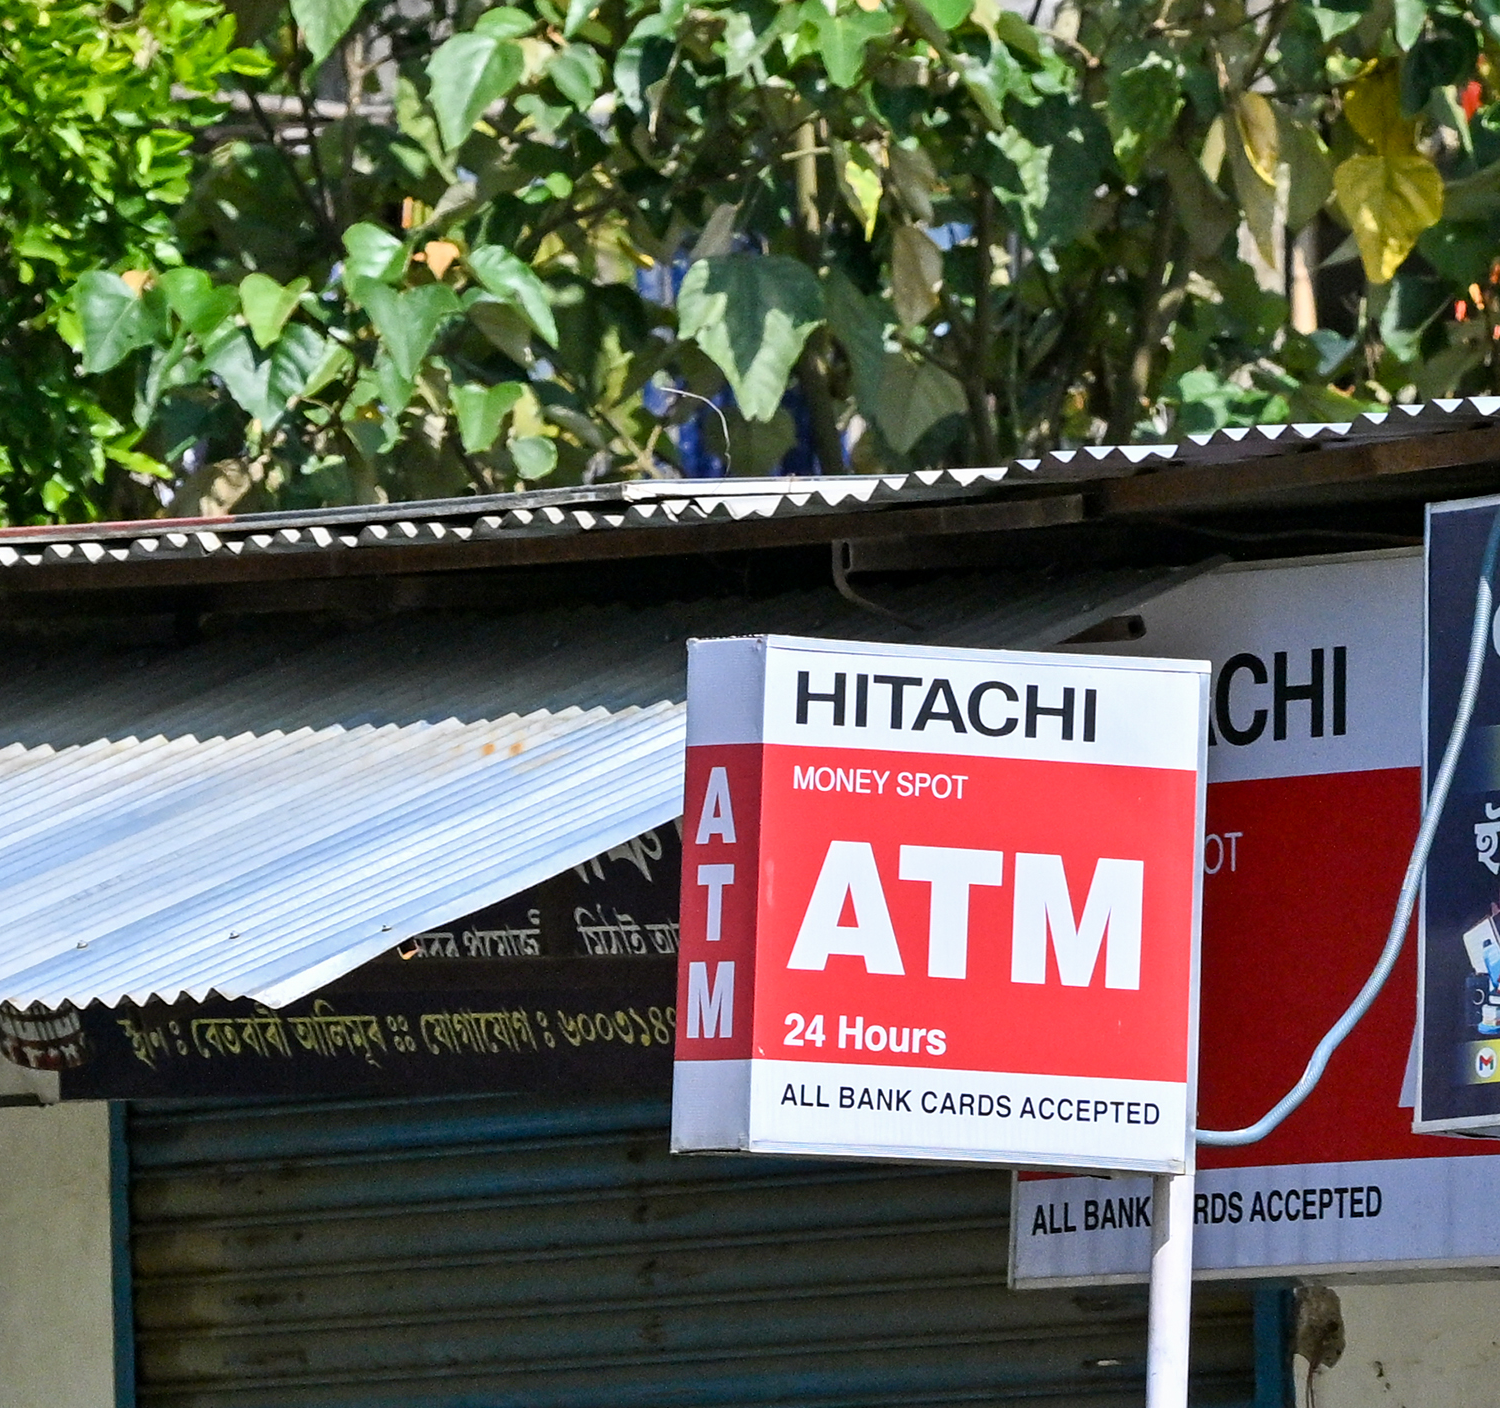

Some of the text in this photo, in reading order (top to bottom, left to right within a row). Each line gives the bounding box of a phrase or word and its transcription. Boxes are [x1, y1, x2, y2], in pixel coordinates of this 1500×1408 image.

[796, 670, 1097, 742] HITACHI
[1208, 646, 1347, 746] CHI
[793, 765, 968, 799] MONEY SPOT
[686, 766, 737, 1041] ATM
[787, 839, 1144, 991] ATM
[783, 1013, 947, 1056] 24 Hours
[781, 1083, 1160, 1126] ALL BANK CARDS ACCEPTED
[1032, 1186, 1382, 1235] ALL BANK RDS ACCEPTED
